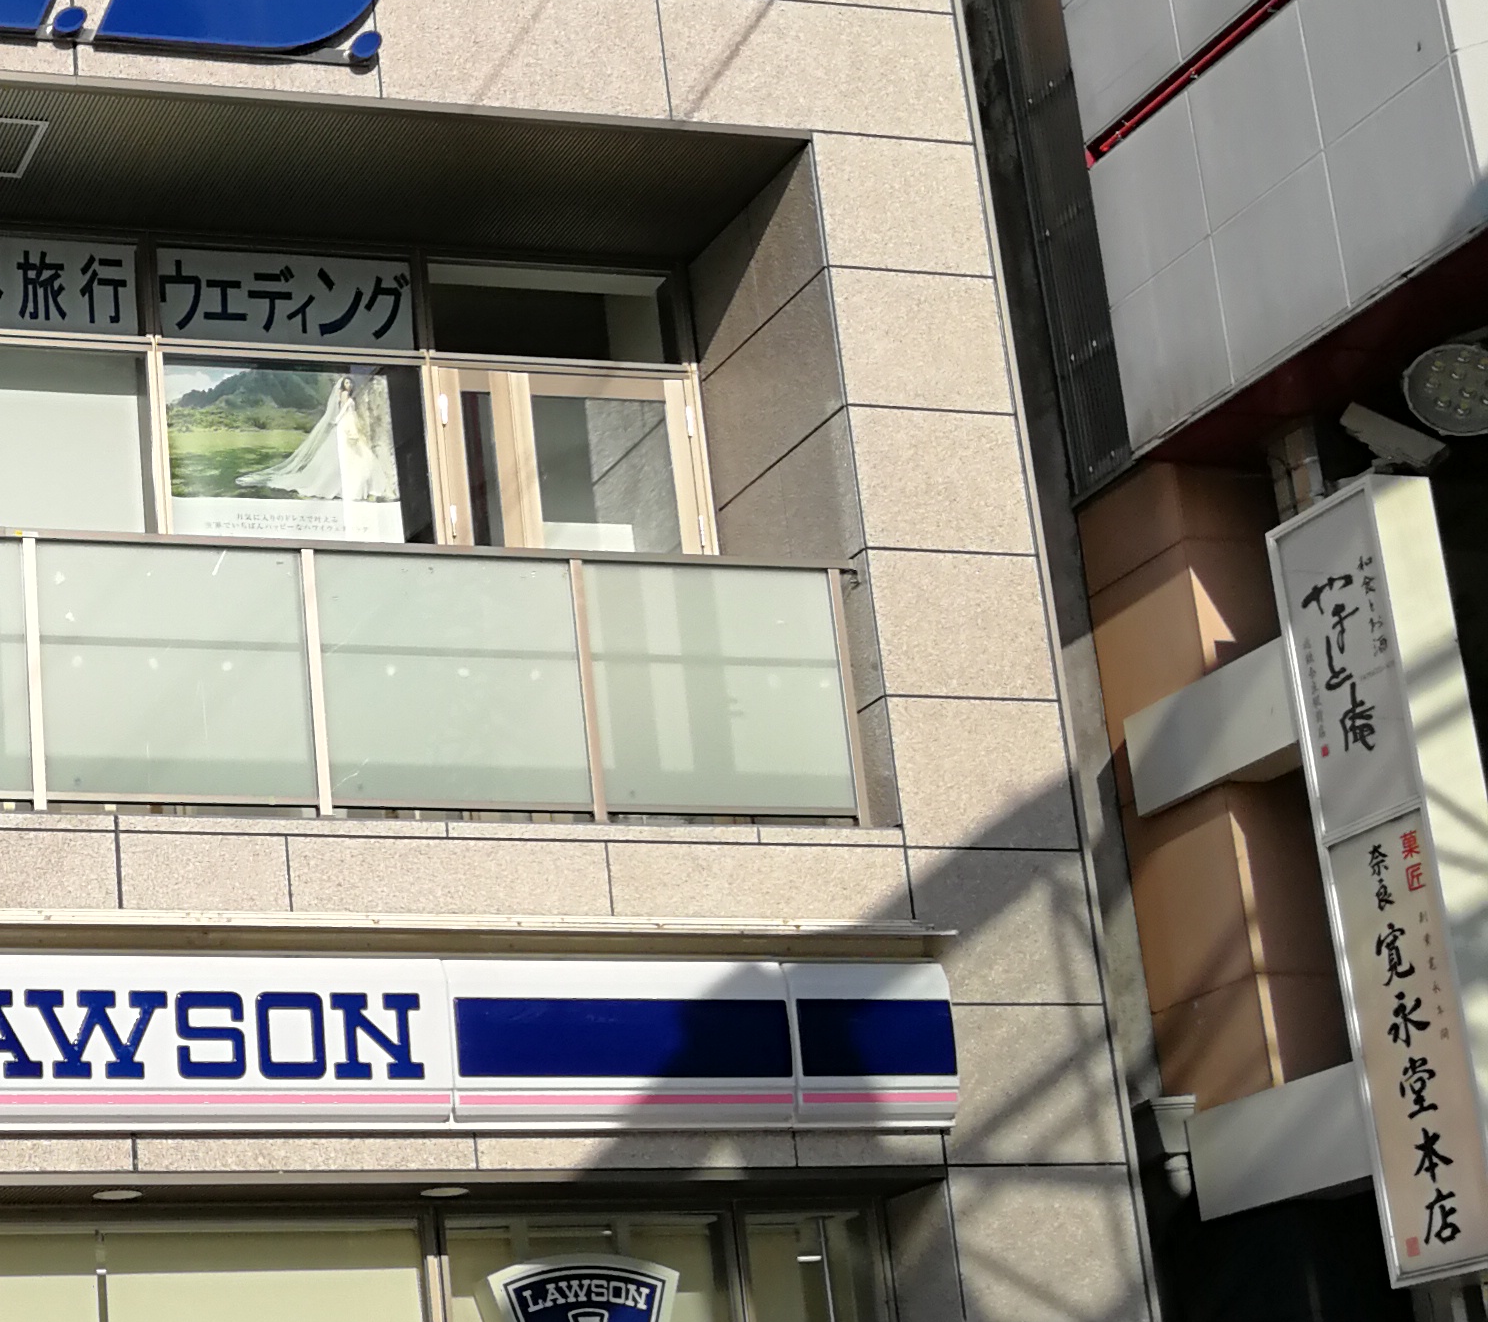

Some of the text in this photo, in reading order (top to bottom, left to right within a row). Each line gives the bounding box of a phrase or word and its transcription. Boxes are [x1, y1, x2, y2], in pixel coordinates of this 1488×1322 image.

[160, 259, 411, 340] ウエディング
[1368, 844, 1395, 912] 奈良
[1400, 830, 1426, 891] 菓匠
[522, 1279, 651, 1313] LAWSON
